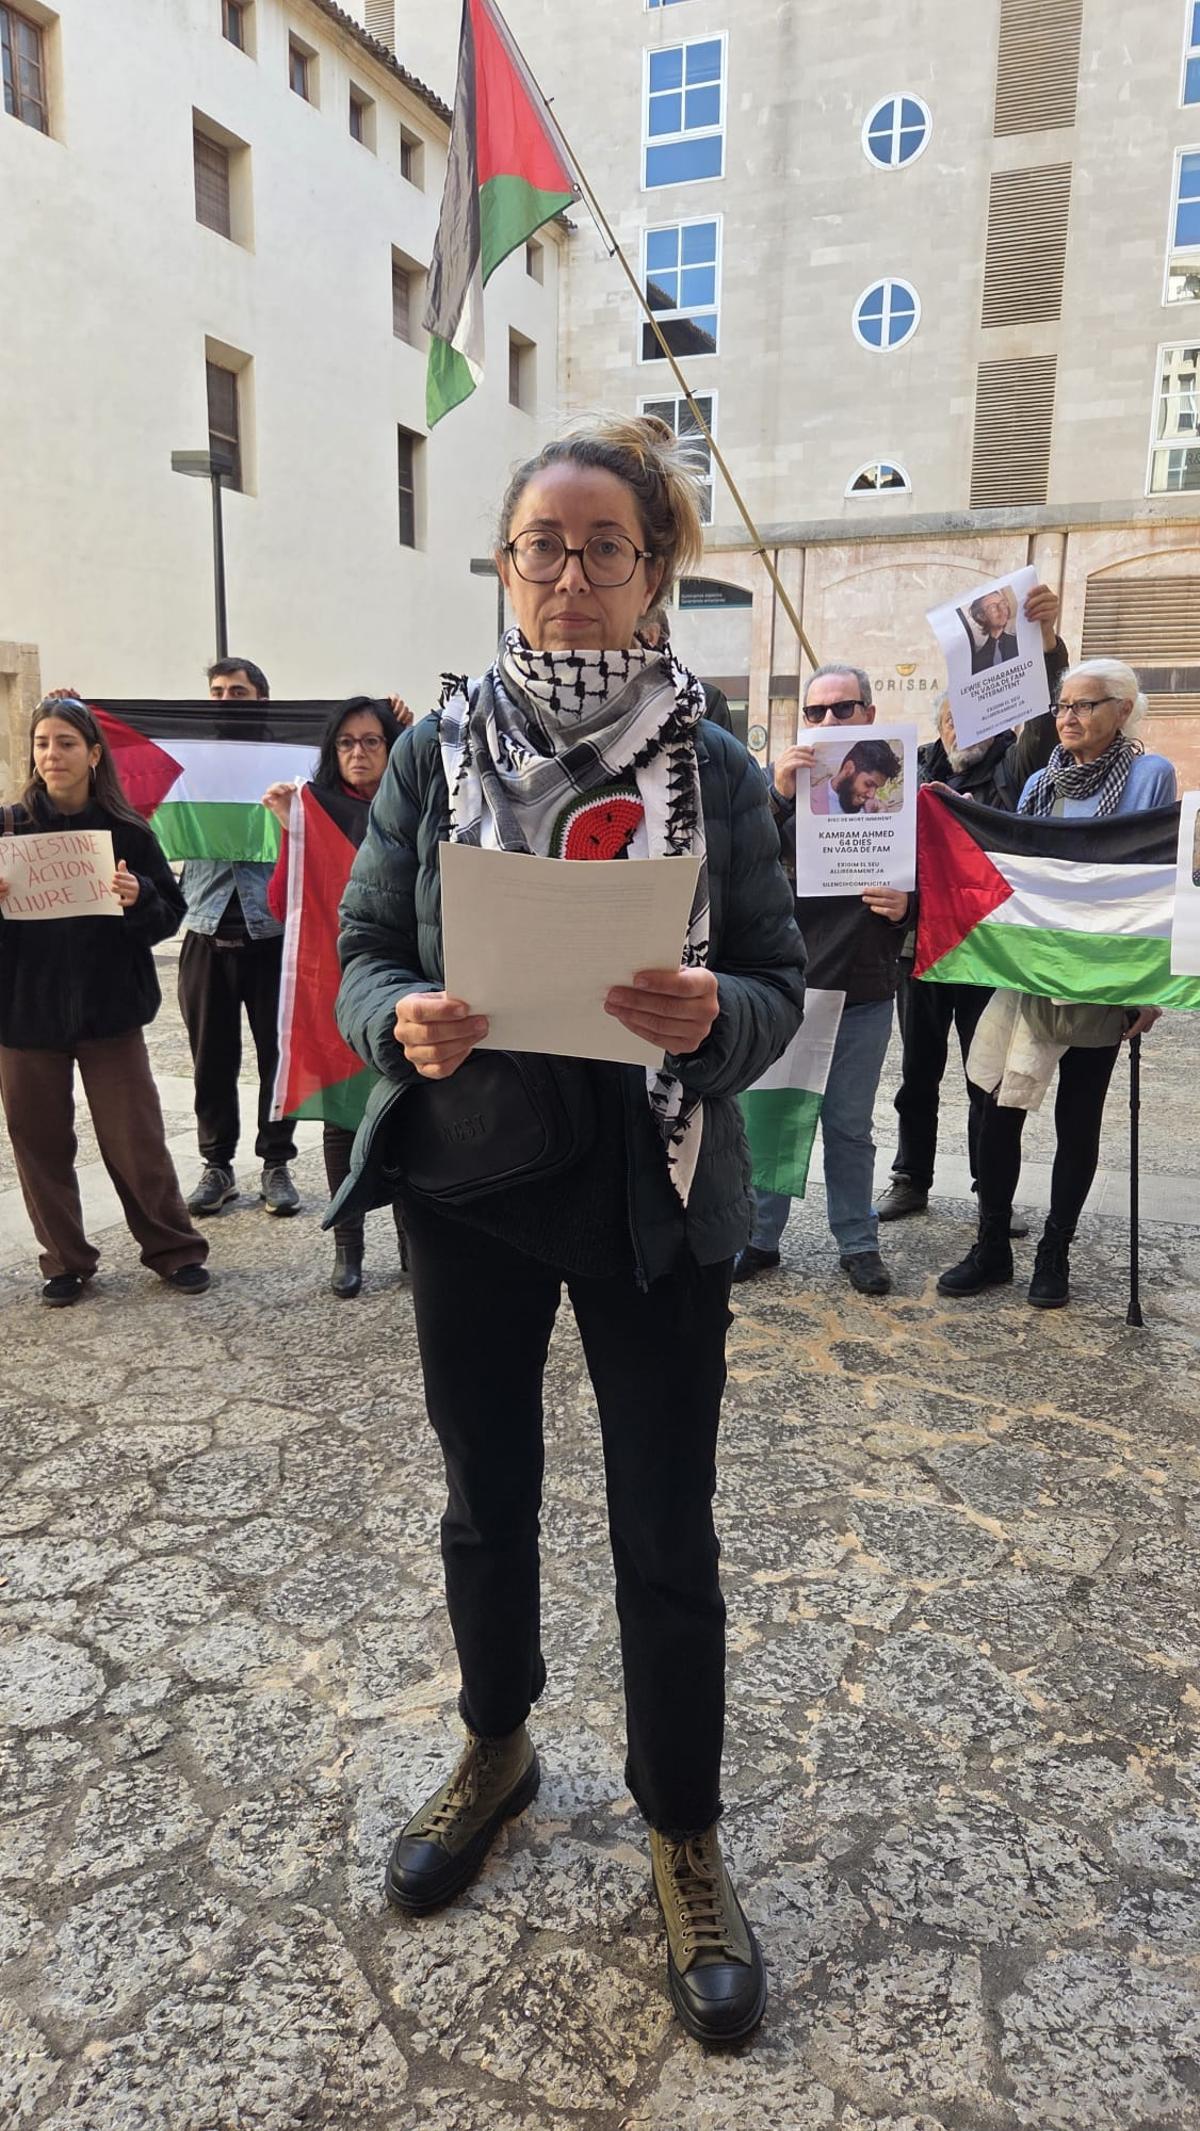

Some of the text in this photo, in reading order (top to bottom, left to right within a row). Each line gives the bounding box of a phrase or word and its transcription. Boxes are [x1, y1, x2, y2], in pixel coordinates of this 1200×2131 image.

[818, 830, 895, 839] KAMRAM AHMED
[852, 838, 872, 846] DIES
[822, 846, 833, 854] EN
[872, 845, 891, 853] FAM
[28, 860, 95, 888] ACTION
